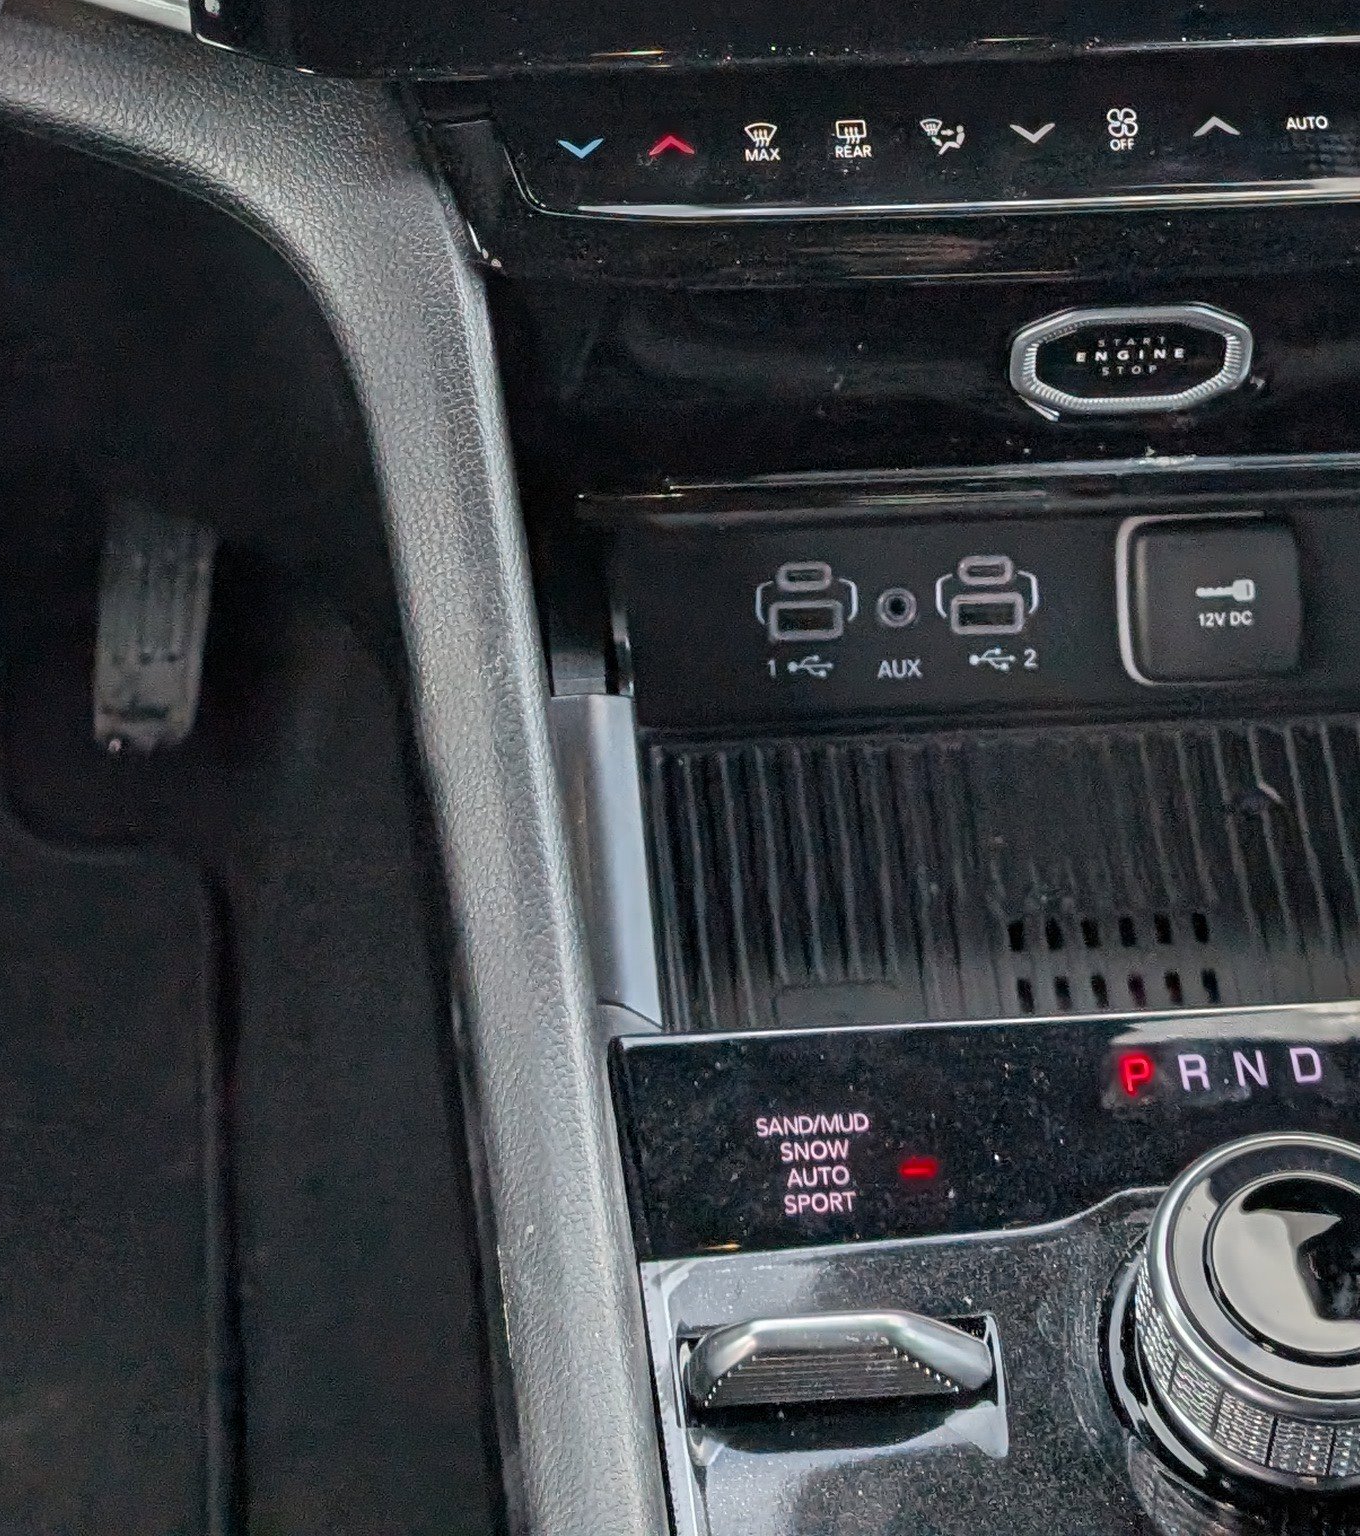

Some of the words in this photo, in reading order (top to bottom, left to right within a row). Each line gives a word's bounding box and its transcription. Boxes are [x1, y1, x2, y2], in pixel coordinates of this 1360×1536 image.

[1285, 115, 1329, 132] AUTO
[835, 144, 872, 159] REAR
[1109, 139, 1135, 152] OFF
[745, 148, 781, 163] MAX
[1097, 336, 1167, 348] START
[1075, 348, 1185, 363] ENGINE
[1101, 364, 1158, 377] STOP
[1198, 612, 1226, 627] 12V
[1229, 611, 1253, 627] DC
[1024, 648, 1037, 667] 2
[767, 659, 777, 677] 1
[877, 659, 923, 679] AUX
[1122, 1052, 1153, 1095] P
[1178, 1053, 1211, 1092] R
[1233, 1050, 1269, 1089] N
[1288, 1046, 1323, 1084] D
[755, 1113, 870, 1139] SAND/MUD
[780, 1140, 850, 1162] SNOW
[787, 1166, 850, 1189] AUTO
[783, 1191, 858, 1215] SPORT
